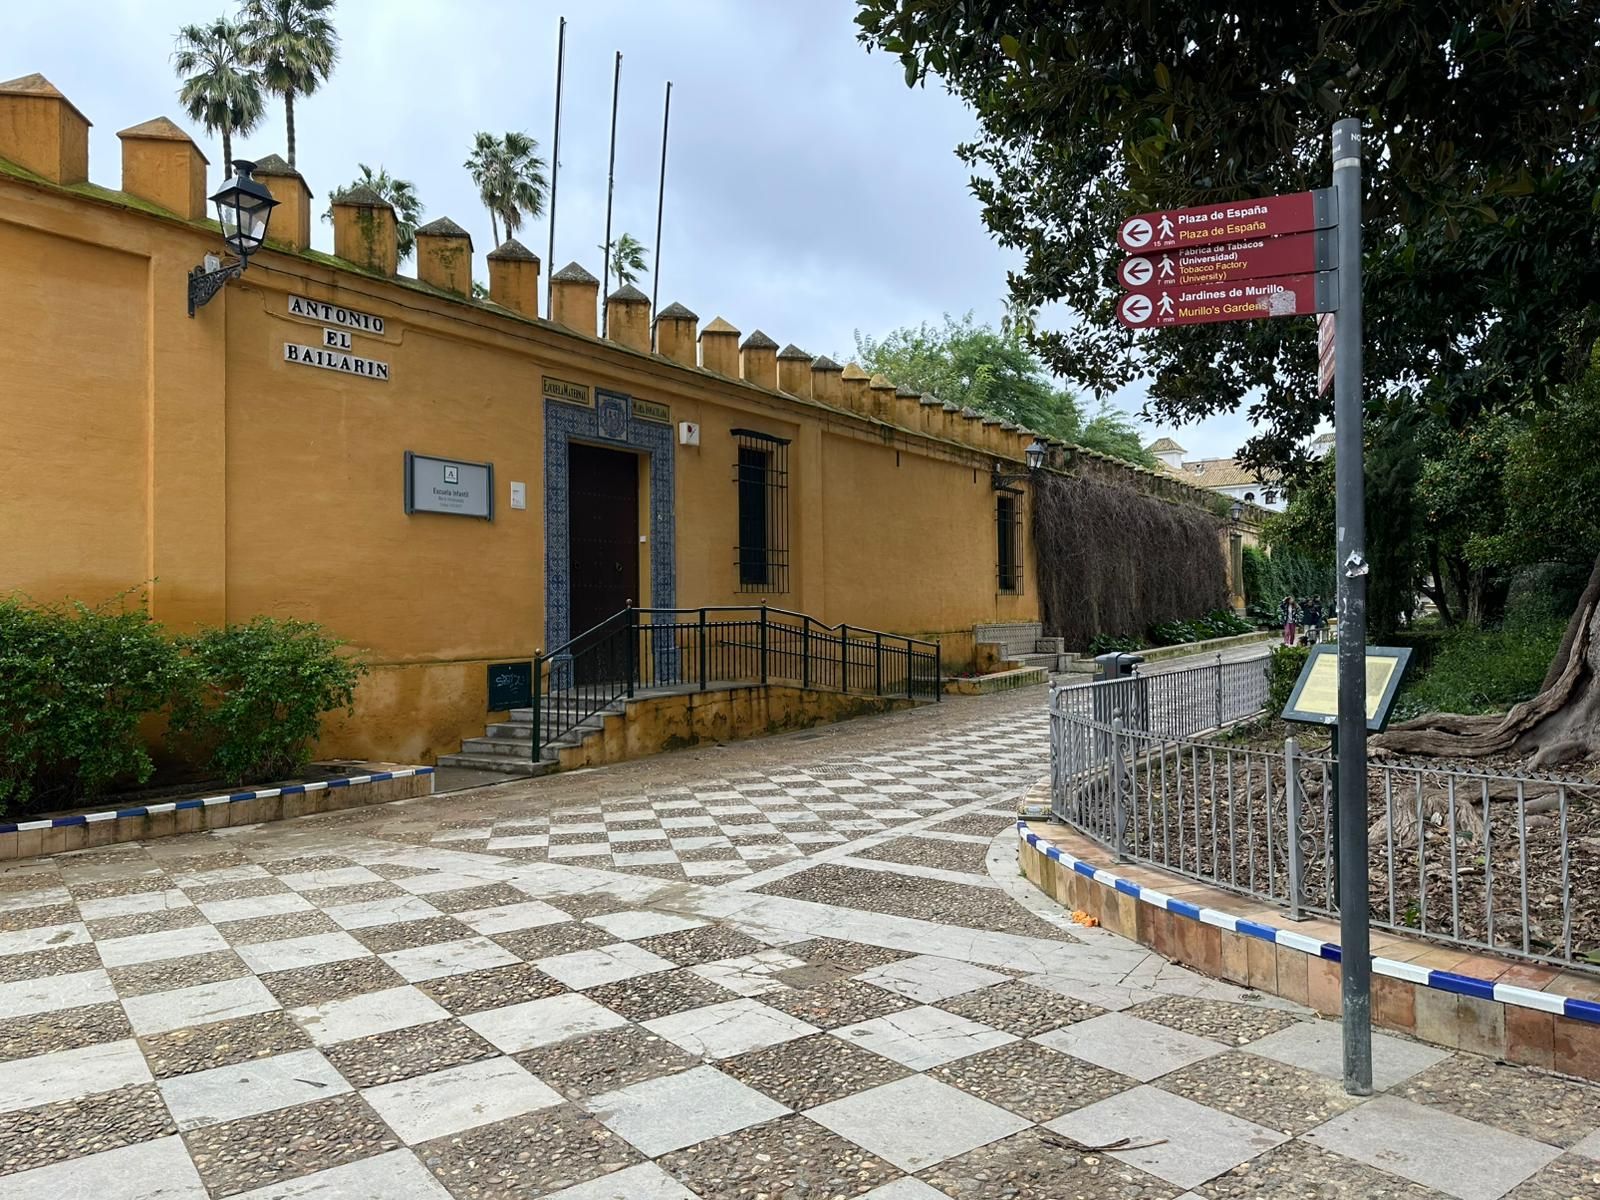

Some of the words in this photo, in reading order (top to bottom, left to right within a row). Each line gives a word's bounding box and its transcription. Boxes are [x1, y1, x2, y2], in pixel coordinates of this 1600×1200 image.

[1178, 214, 1208, 225] Plaza
[1210, 211, 1224, 220] de
[1226, 205, 1268, 218] España
[1179, 229, 1209, 240] Plaza
[1211, 226, 1224, 236] de
[1226, 221, 1266, 234] España
[1213, 244, 1225, 253] de
[1227, 240, 1264, 251] Tabacos
[1179, 252, 1238, 266] (Universidad)
[1179, 264, 1214, 274] Tobacco
[1215, 260, 1248, 271] Factory
[1179, 271, 1227, 285] (University)
[1178, 290, 1226, 302] Jardines
[1228, 287, 1243, 297] de
[1245, 284, 1285, 296] Murillo
[291, 298, 383, 332] ANTONIO
[1178, 305, 1220, 318] Murillo's
[1222, 302, 1268, 313] Gardens
[326, 331, 351, 349] EL
[287, 344, 388, 378] BAILARIN
